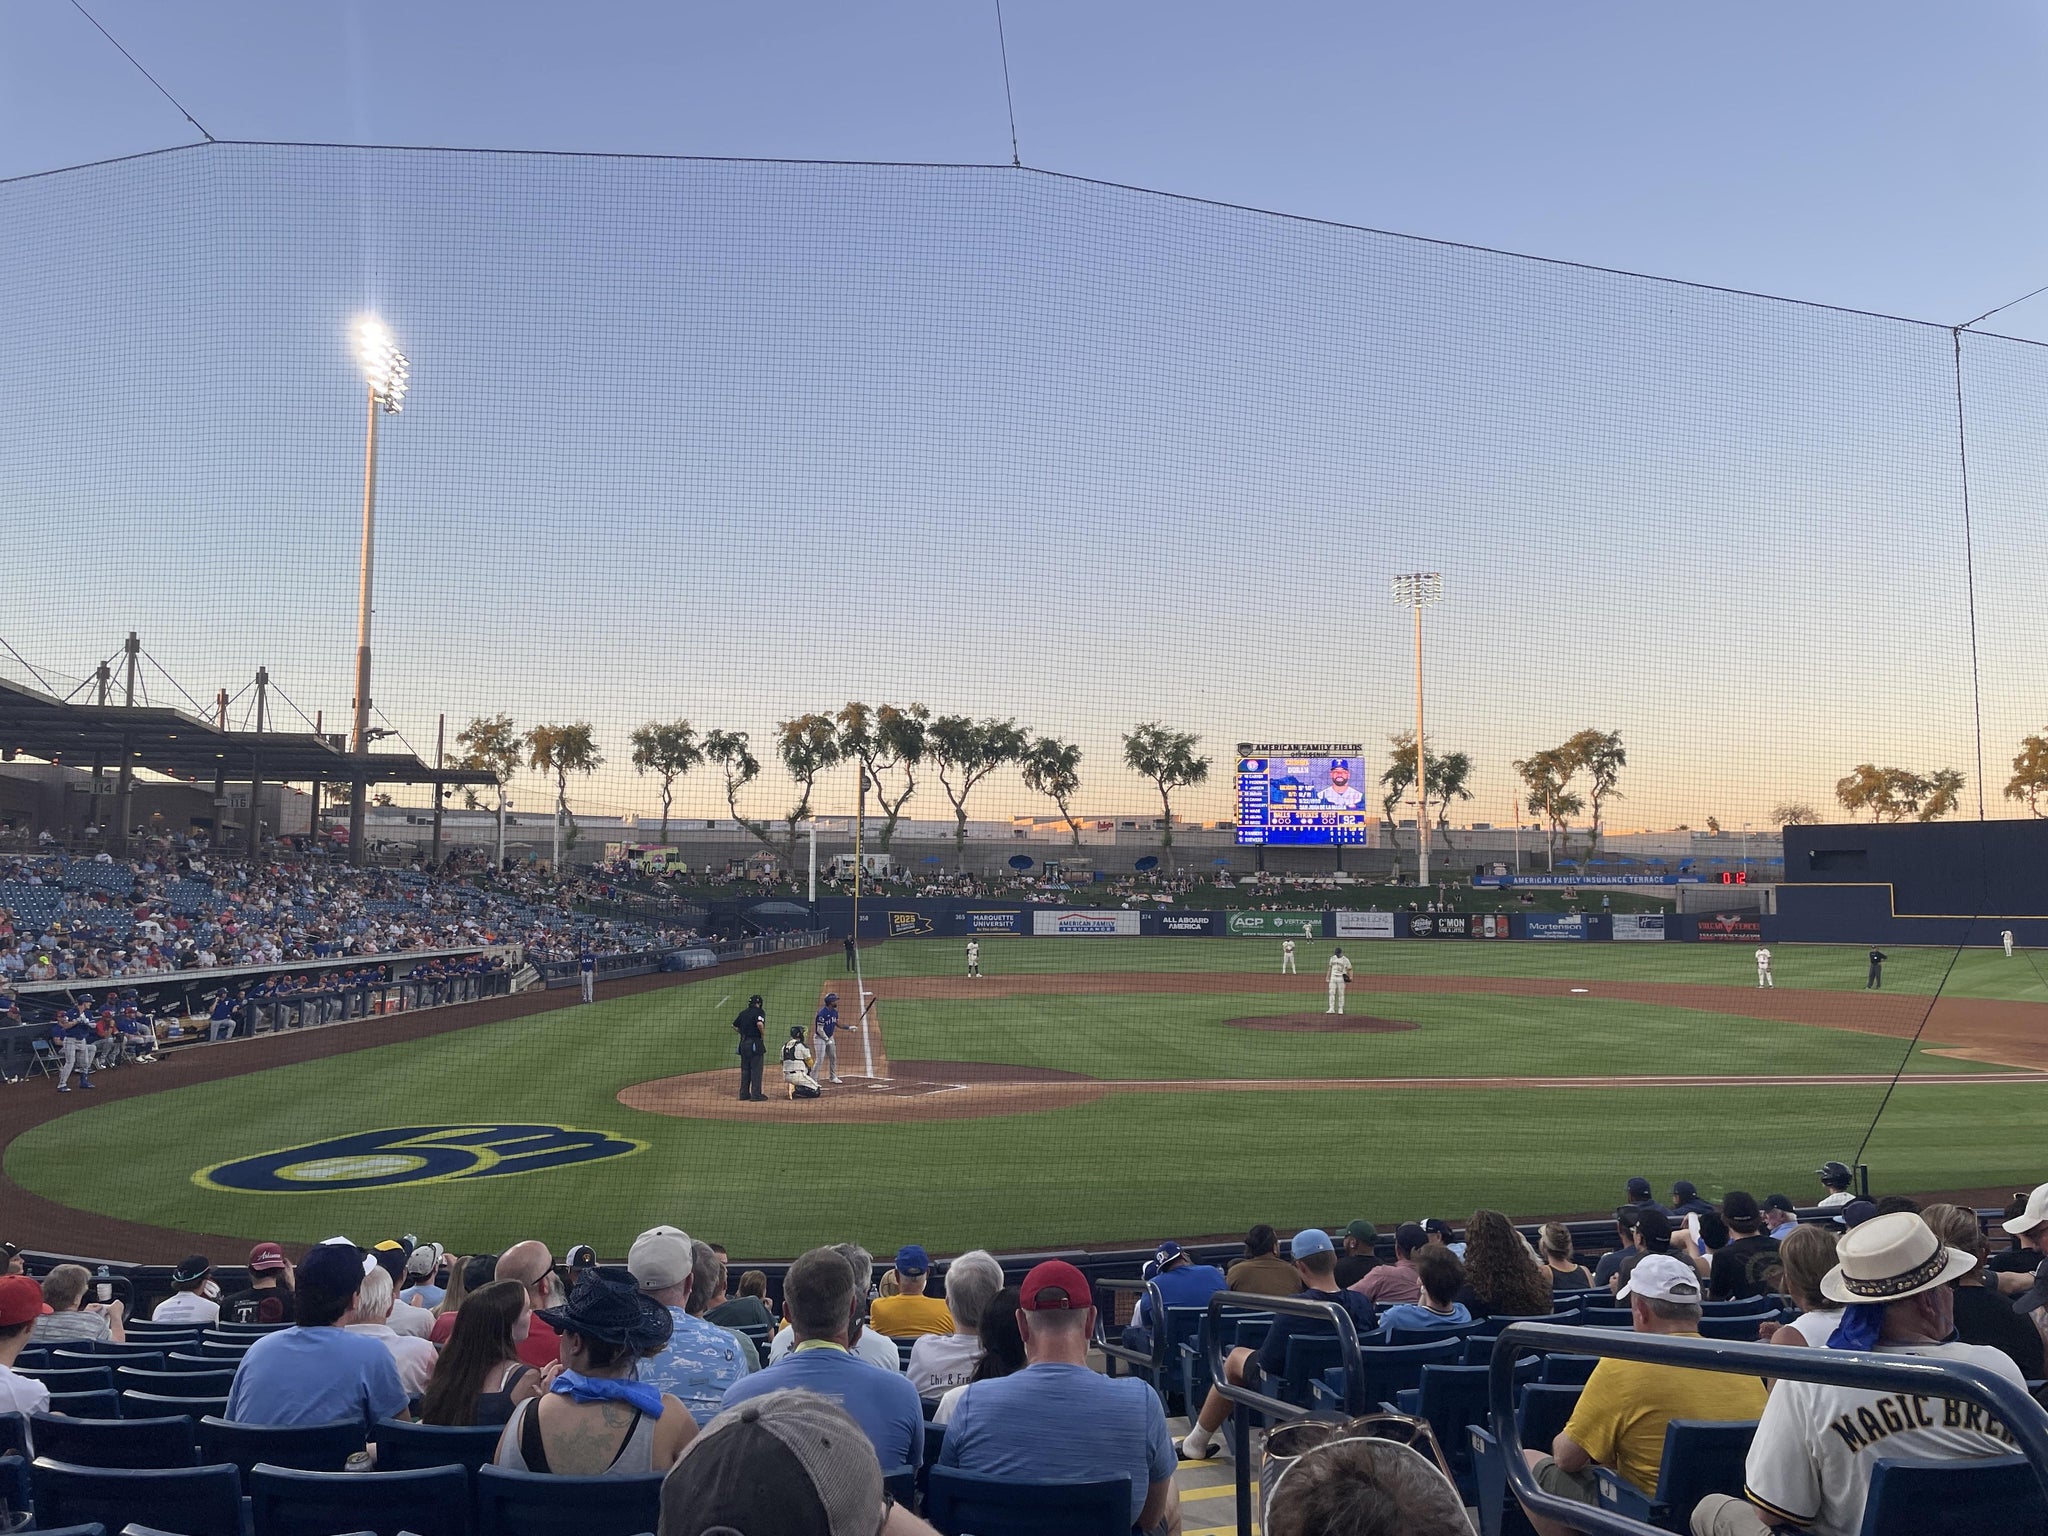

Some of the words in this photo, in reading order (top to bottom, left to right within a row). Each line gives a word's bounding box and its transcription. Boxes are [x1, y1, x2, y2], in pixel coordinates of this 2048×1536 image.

[94, 784, 112, 793] 114
[1344, 816, 1355, 824] 92
[1723, 872, 1730, 884] 0
[1736, 872, 1746, 884] 12
[894, 915, 916, 924] 2025
[1439, 918, 1464, 927] C'MON
[238, 1308, 252, 1323] T
[948, 1374, 953, 1384] &
[1831, 1394, 1932, 1452] MAGIC
